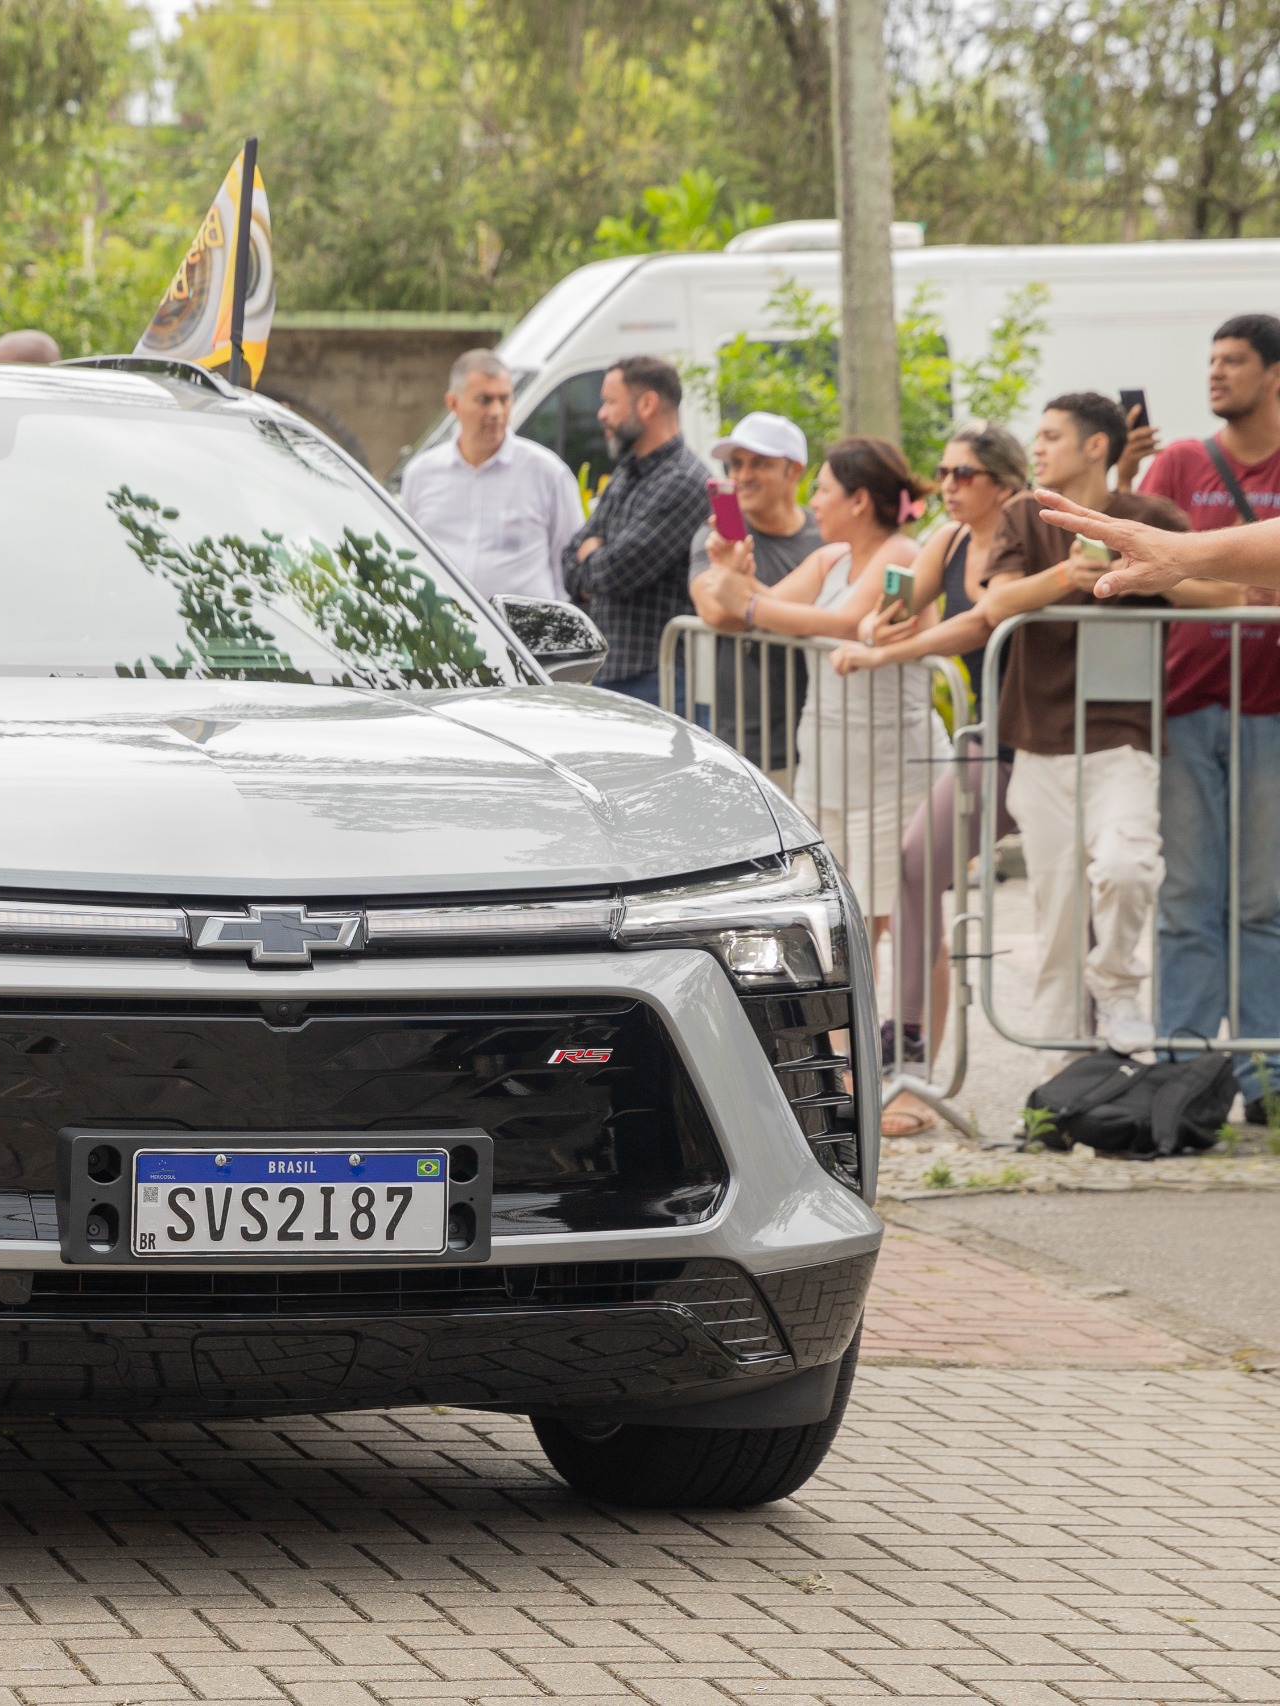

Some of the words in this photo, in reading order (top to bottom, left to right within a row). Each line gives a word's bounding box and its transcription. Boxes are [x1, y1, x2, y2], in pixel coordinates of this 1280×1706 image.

[547, 1048, 614, 1064] RS
[268, 1160, 317, 1174] BRASIL
[166, 1186, 413, 1242] SVS2I87
[139, 1232, 156, 1250] BR
